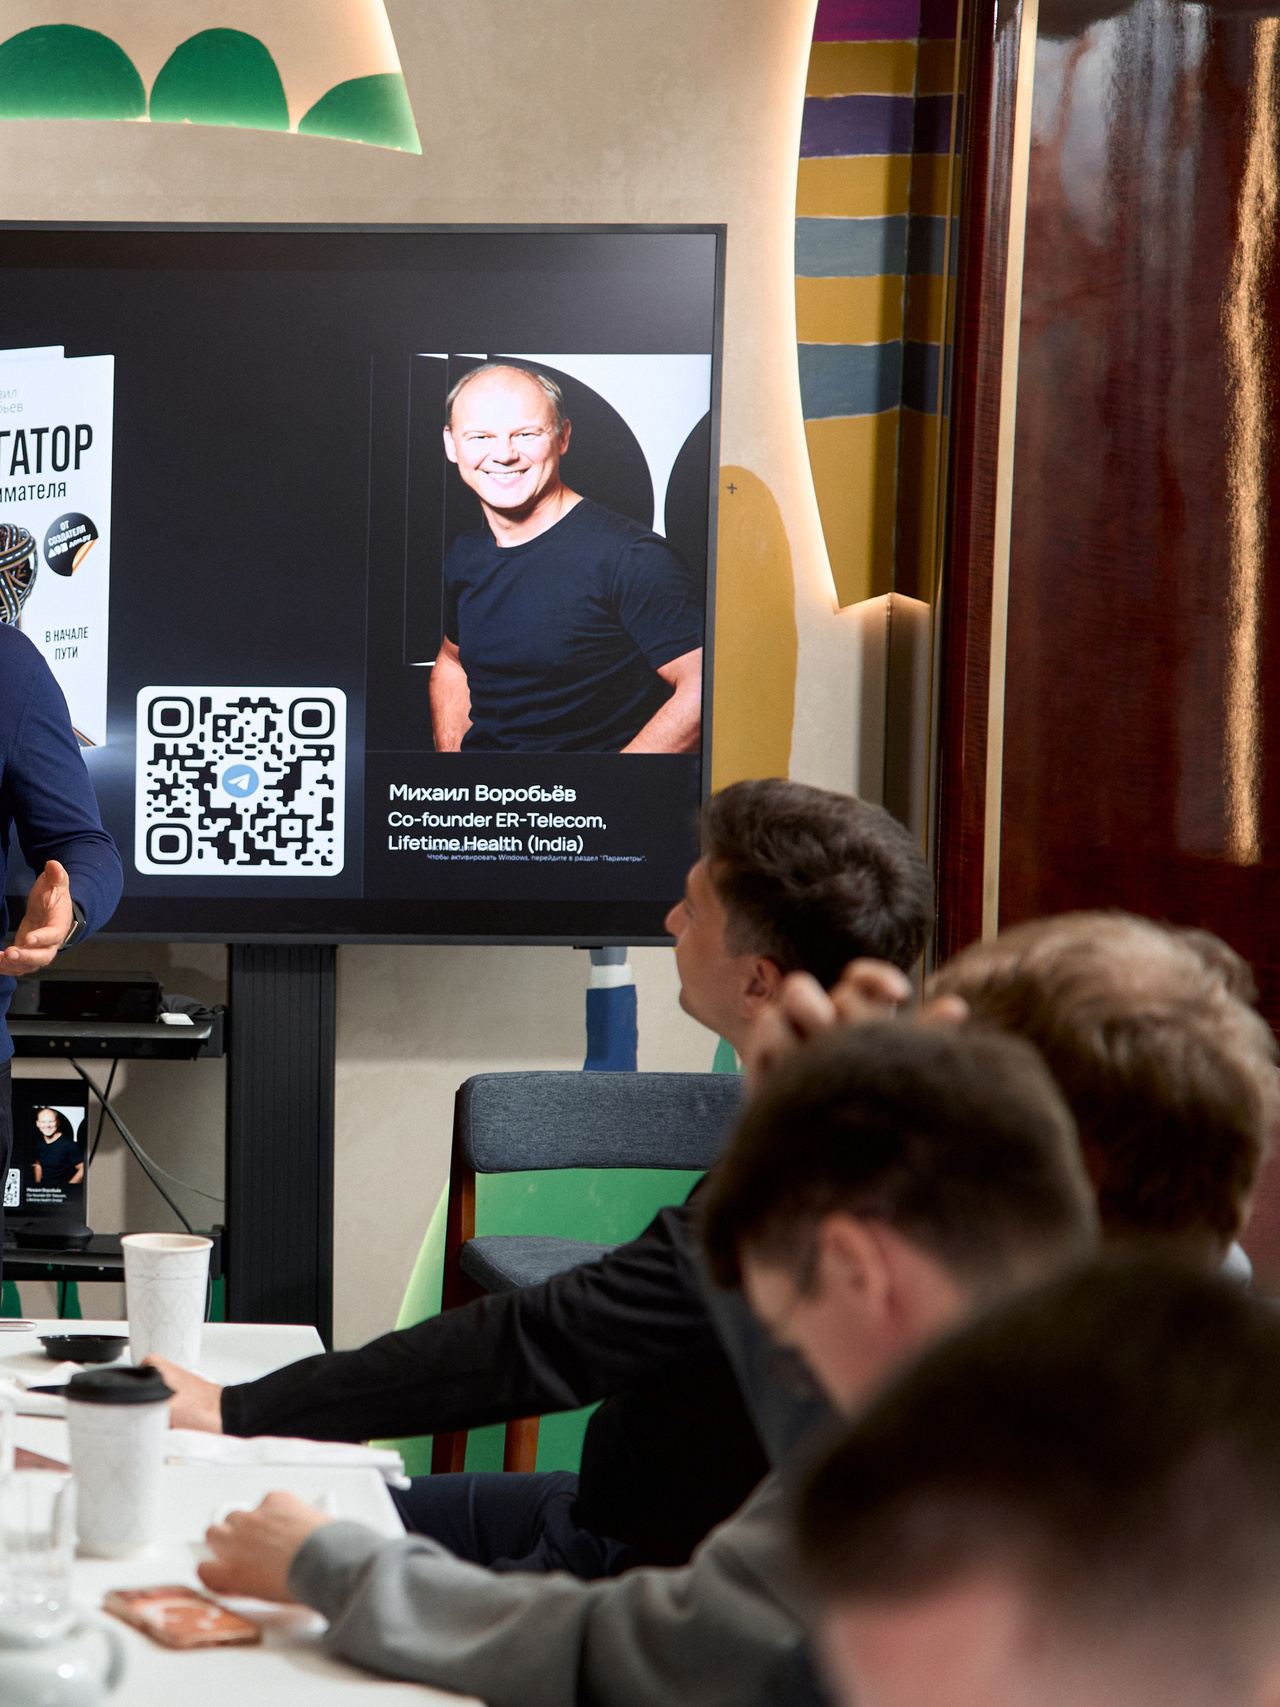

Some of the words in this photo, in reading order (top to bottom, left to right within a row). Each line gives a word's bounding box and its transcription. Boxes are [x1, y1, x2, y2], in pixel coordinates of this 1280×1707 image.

[59, 520, 70, 531] ОТ
[48, 524, 87, 547] СОЗДАТЕЛЯ
[45, 630, 52, 643] В
[54, 626, 89, 642] НАЧАЛЕ
[55, 646, 79, 660] ПУТИ
[389, 783, 470, 802] Михаил
[474, 784, 577, 805] Воробьёв
[388, 811, 493, 828] Co-founder
[495, 812, 608, 831] ER-Telecom,
[388, 834, 463, 851] Lifetime
[464, 835, 523, 852] Health
[528, 835, 585, 855] (India)
[574, 855, 599, 863] раздел
